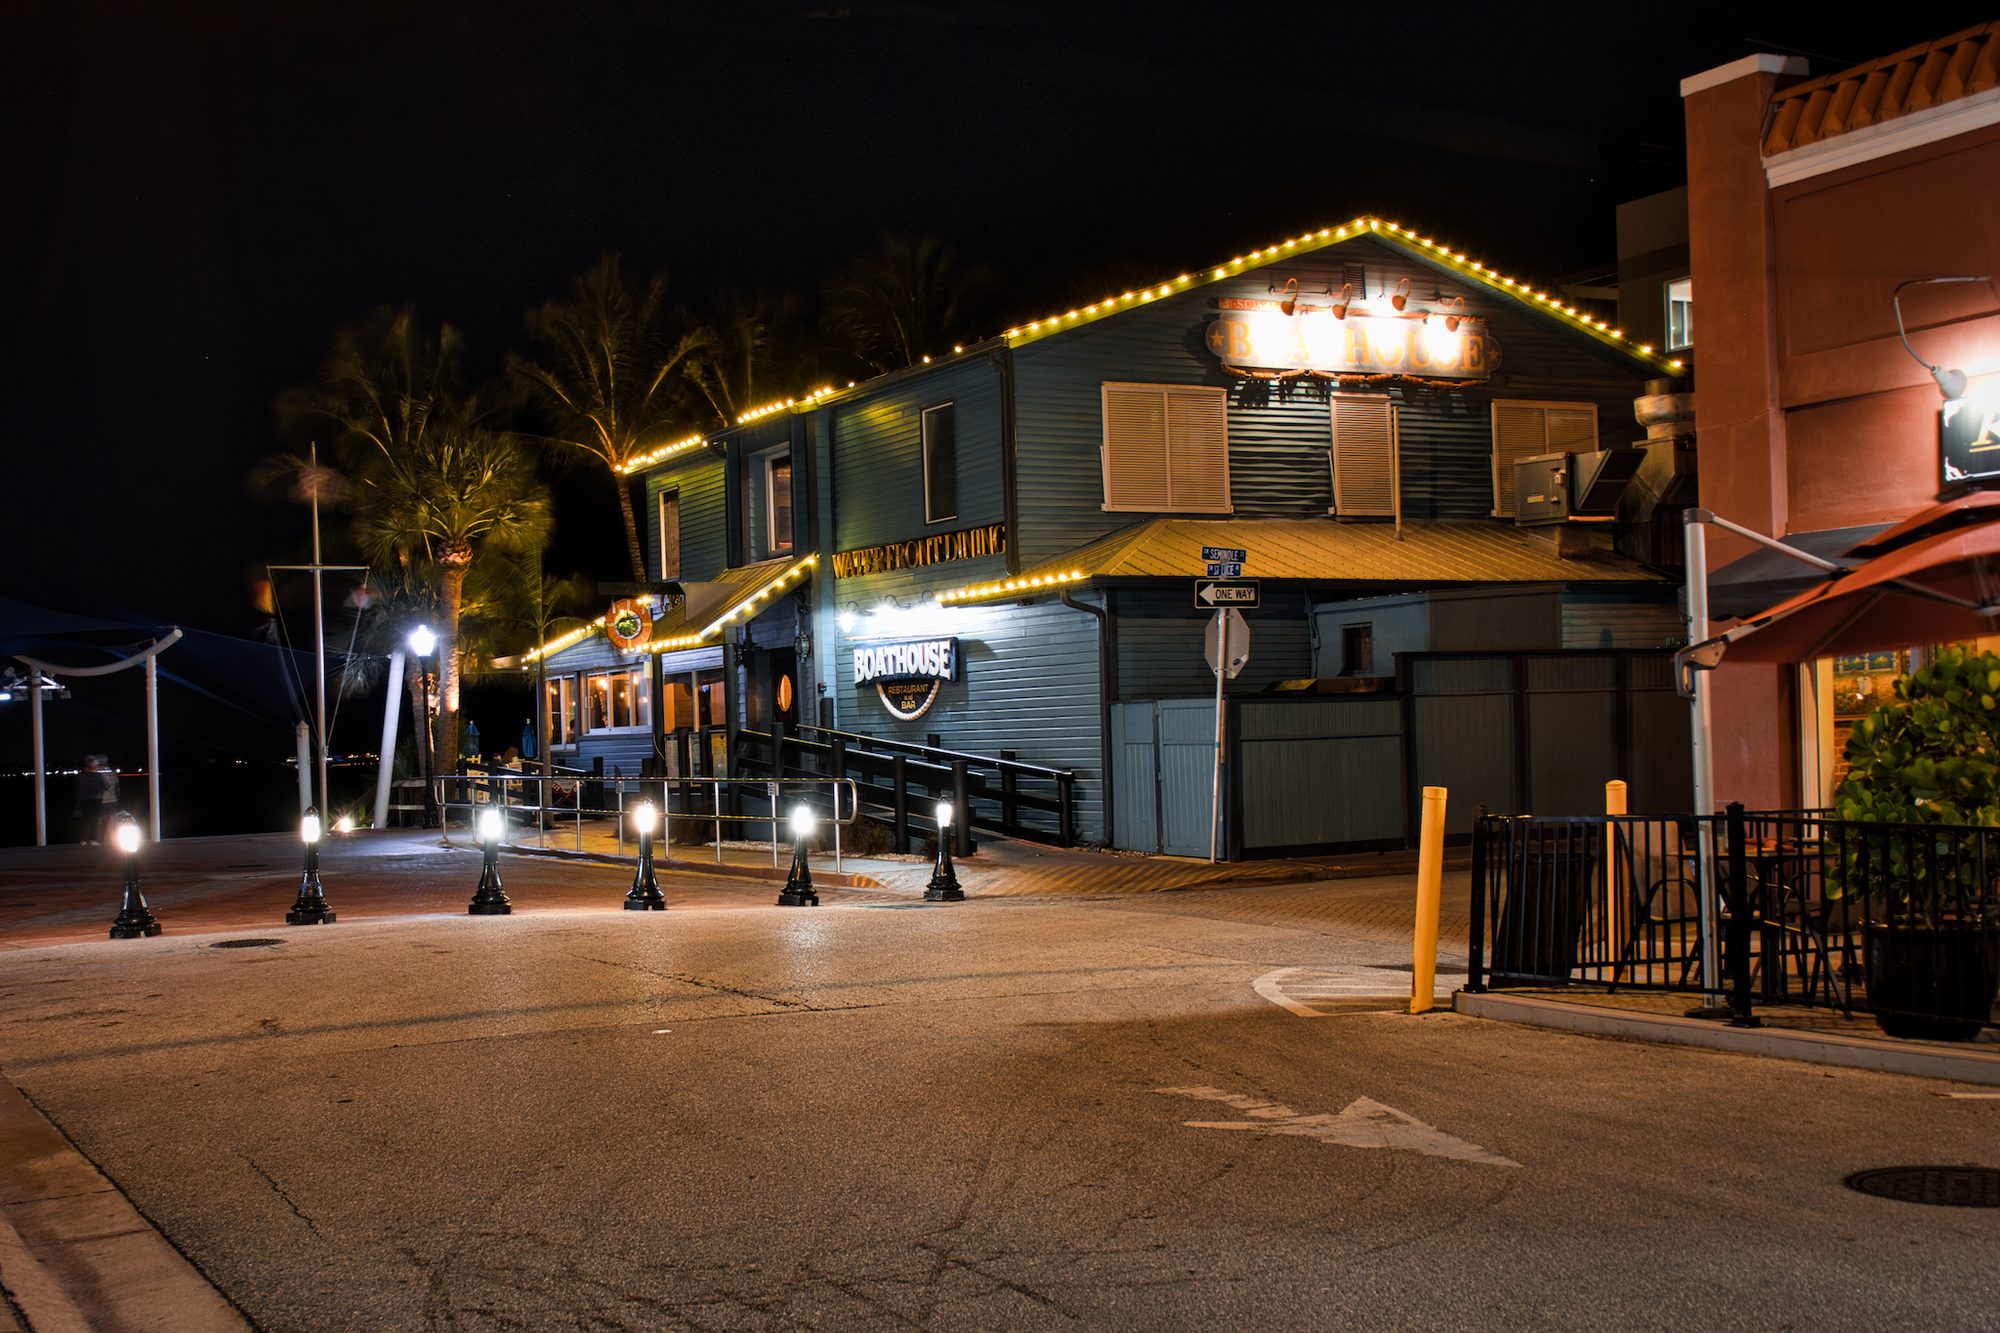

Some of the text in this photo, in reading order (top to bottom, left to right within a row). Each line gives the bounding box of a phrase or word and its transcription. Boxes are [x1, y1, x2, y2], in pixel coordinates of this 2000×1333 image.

[944, 524, 1006, 562] DINING
[1210, 548, 1239, 561] SEMINOLE
[1215, 589, 1253, 599] ONE WAY
[853, 640, 951, 684] BOATHOUSE
[888, 684, 929, 695] RESTAURANT
[901, 700, 916, 710] BAR
